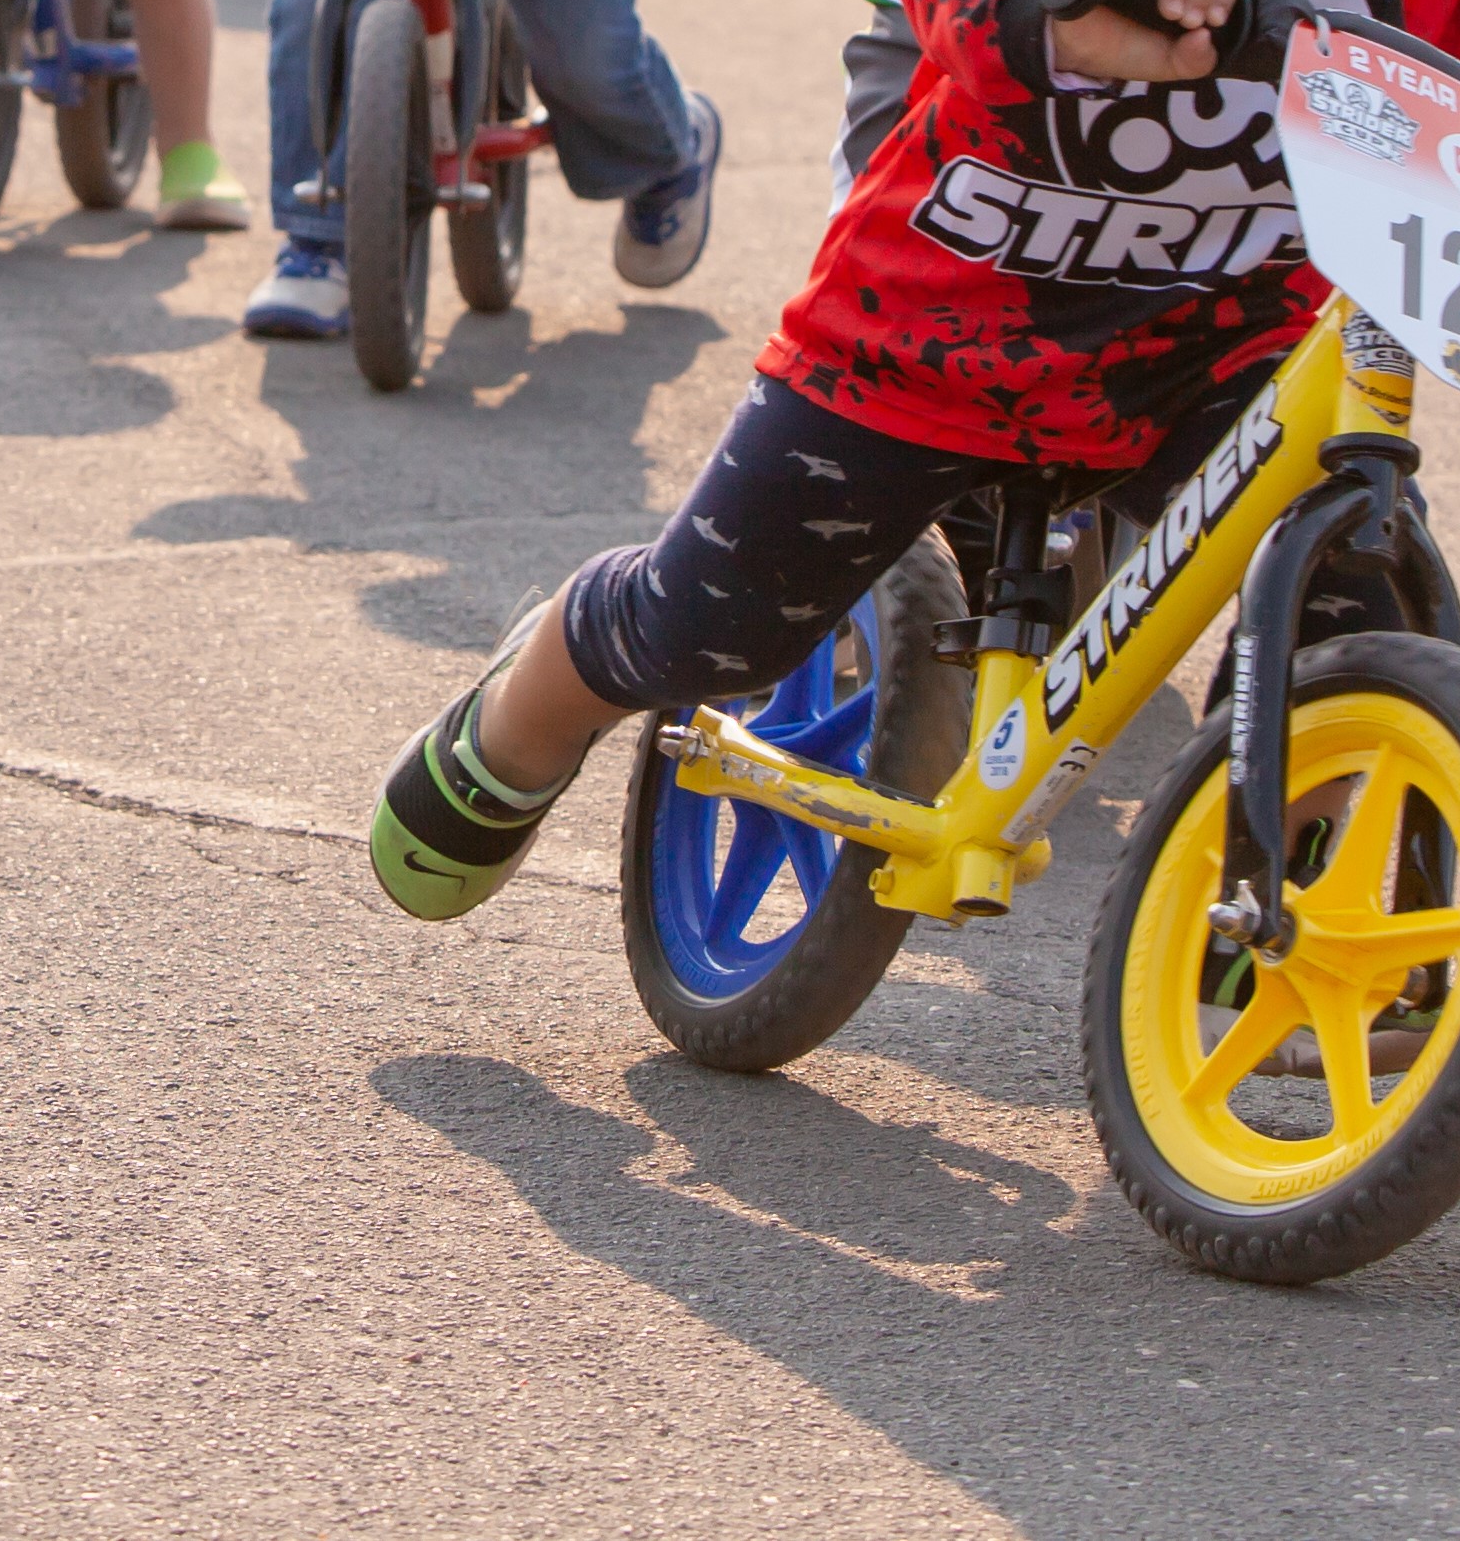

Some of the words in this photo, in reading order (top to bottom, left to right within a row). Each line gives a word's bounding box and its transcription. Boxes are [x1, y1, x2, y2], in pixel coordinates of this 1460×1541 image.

[1348, 45, 1372, 74] 2
[1377, 55, 1458, 112] YEAR
[1311, 91, 1412, 149] STRIDER
[1044, 379, 1284, 731] STRIDER
[993, 709, 1019, 750] 5
